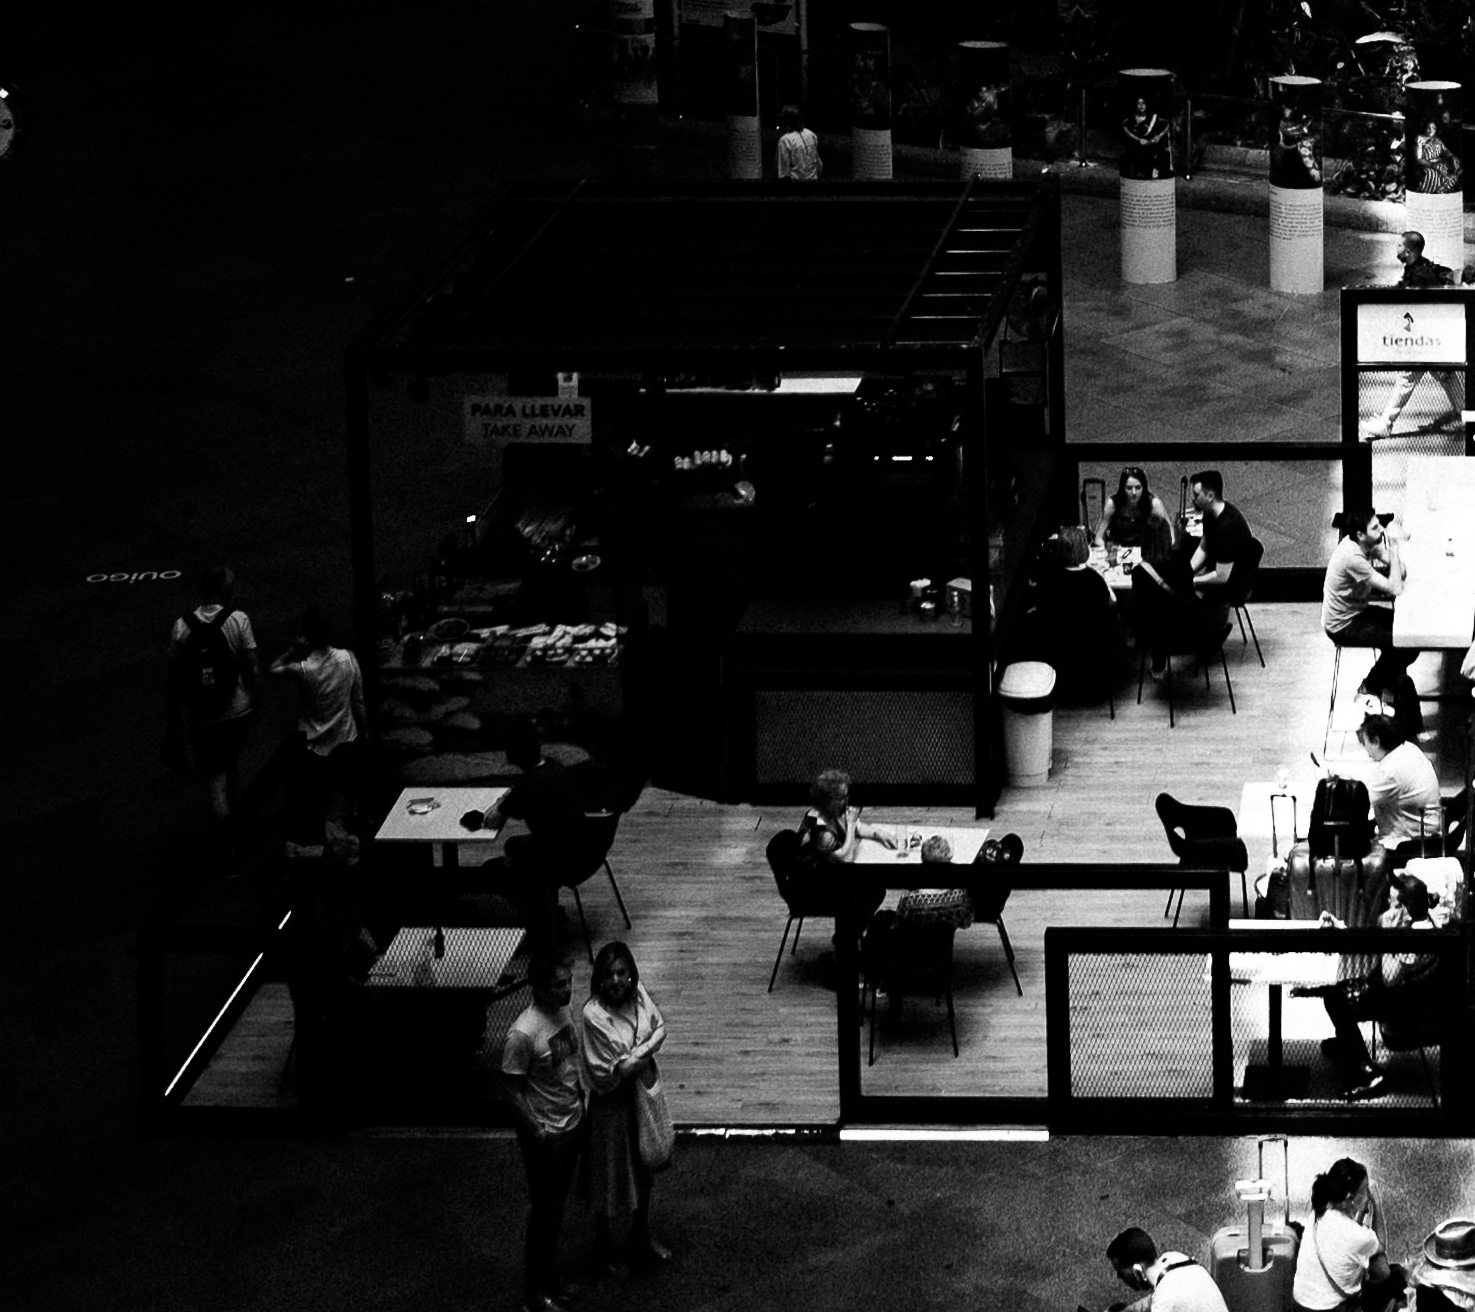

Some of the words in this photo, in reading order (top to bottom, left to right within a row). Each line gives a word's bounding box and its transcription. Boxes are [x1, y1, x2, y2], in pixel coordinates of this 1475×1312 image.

[1383, 336, 1441, 346] tiendas
[472, 404, 516, 417] PARA
[522, 404, 585, 417] LLEVAR
[483, 425, 521, 438] TAKE
[528, 425, 575, 437] AWAY
